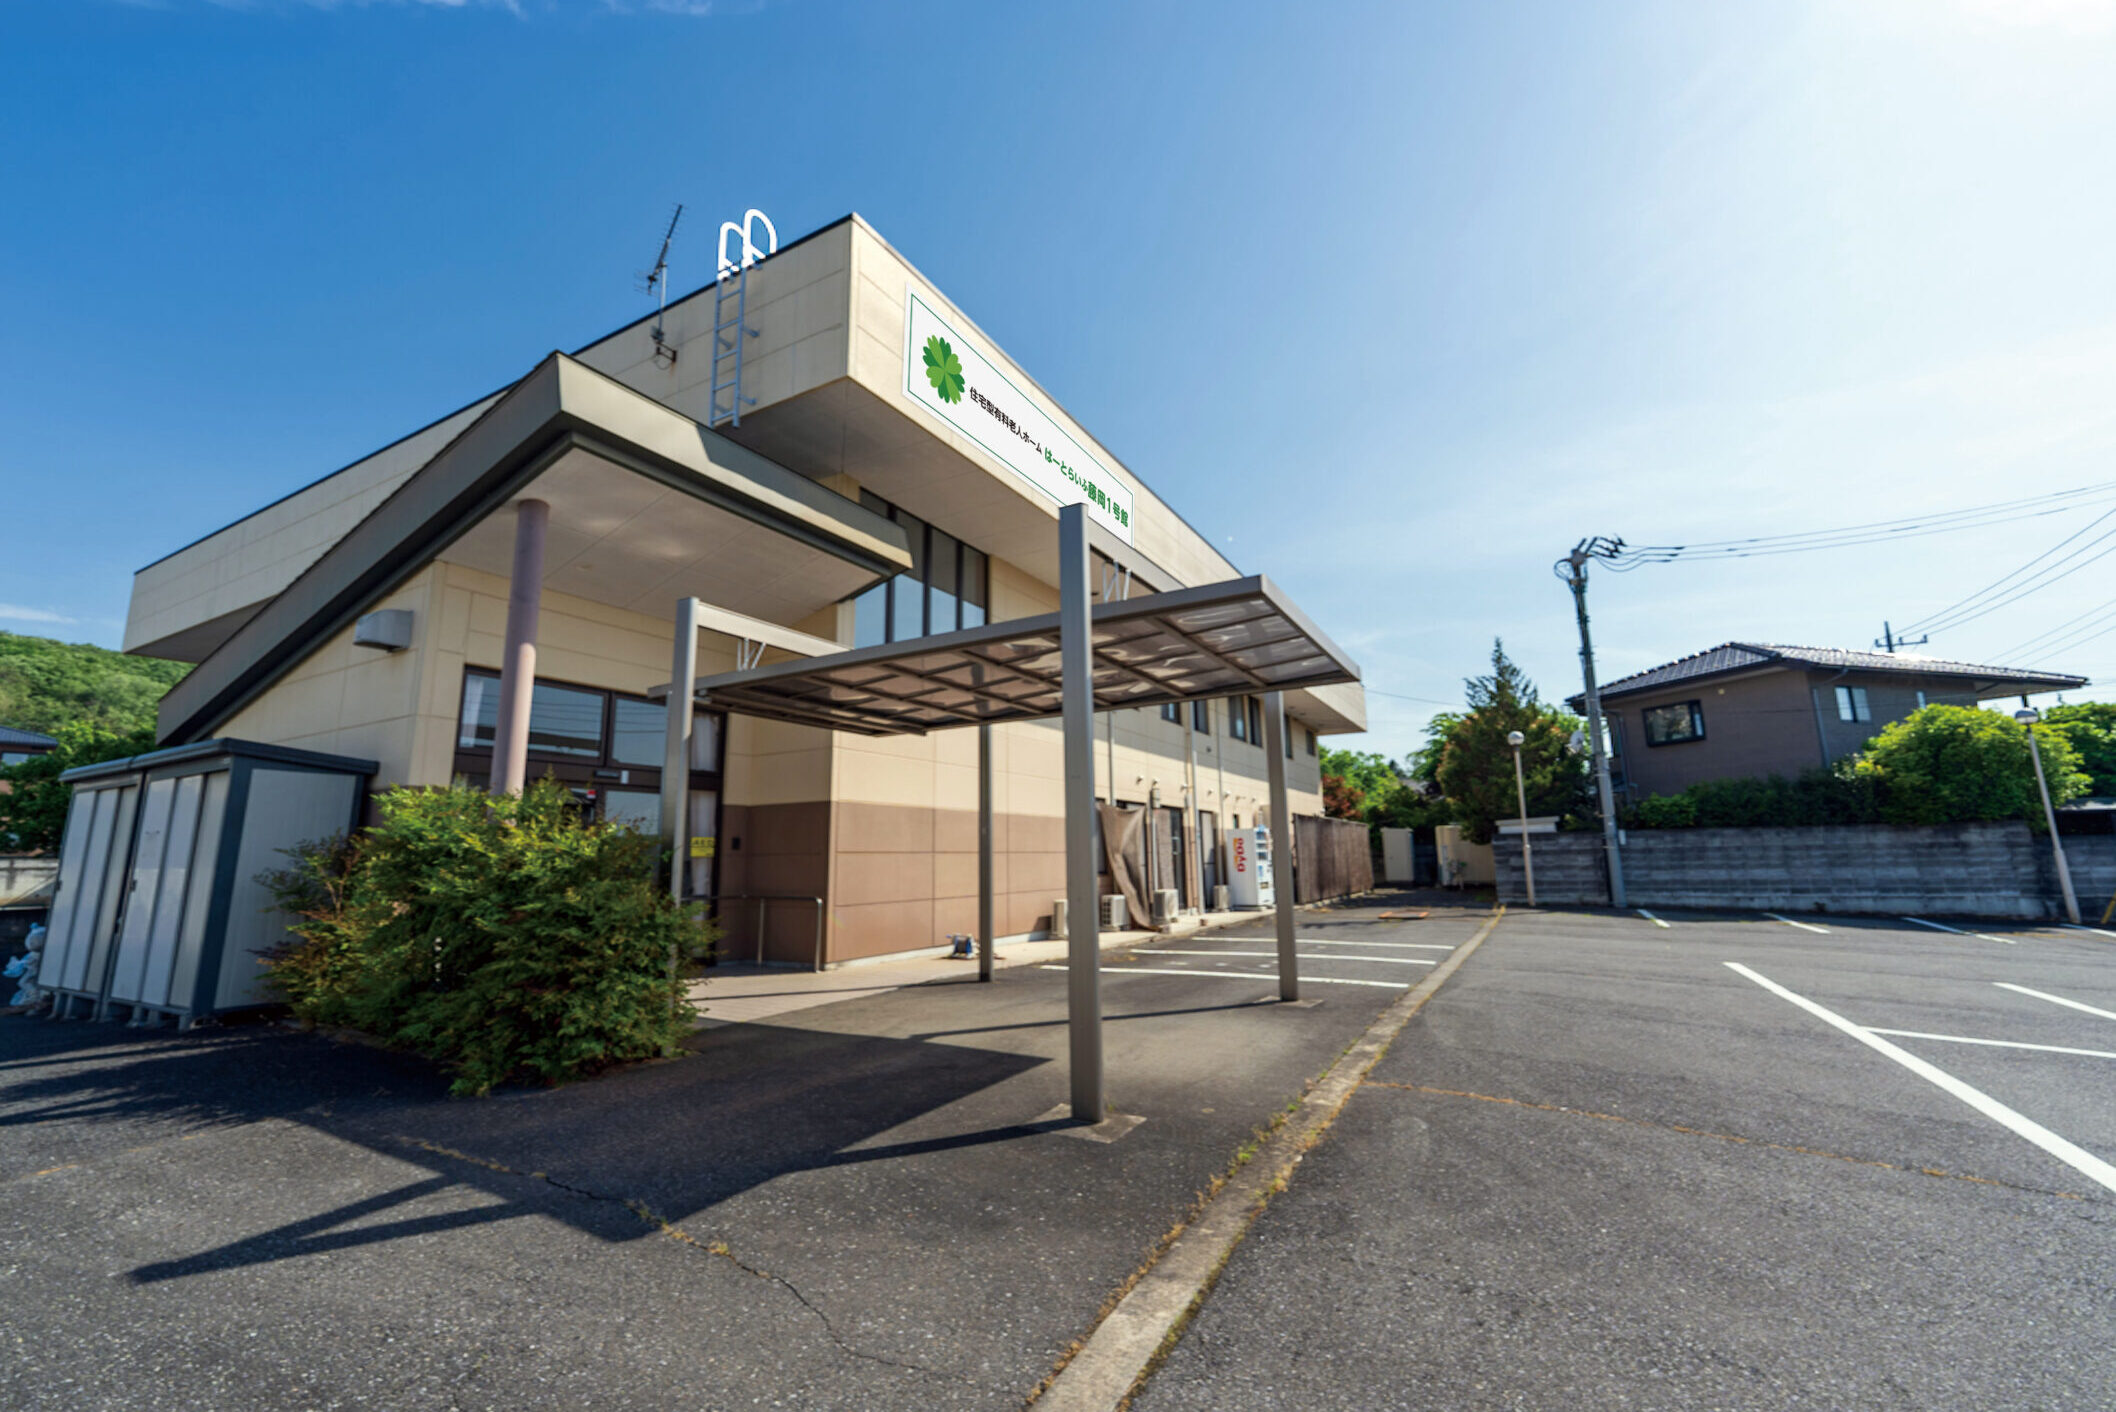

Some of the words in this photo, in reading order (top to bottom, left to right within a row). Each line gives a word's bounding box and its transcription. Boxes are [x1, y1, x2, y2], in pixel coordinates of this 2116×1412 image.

[969, 386, 1042, 455] 住宅型有料老人ホーム
[1044, 446, 1129, 528] はーとらいふ藤岡1号館
